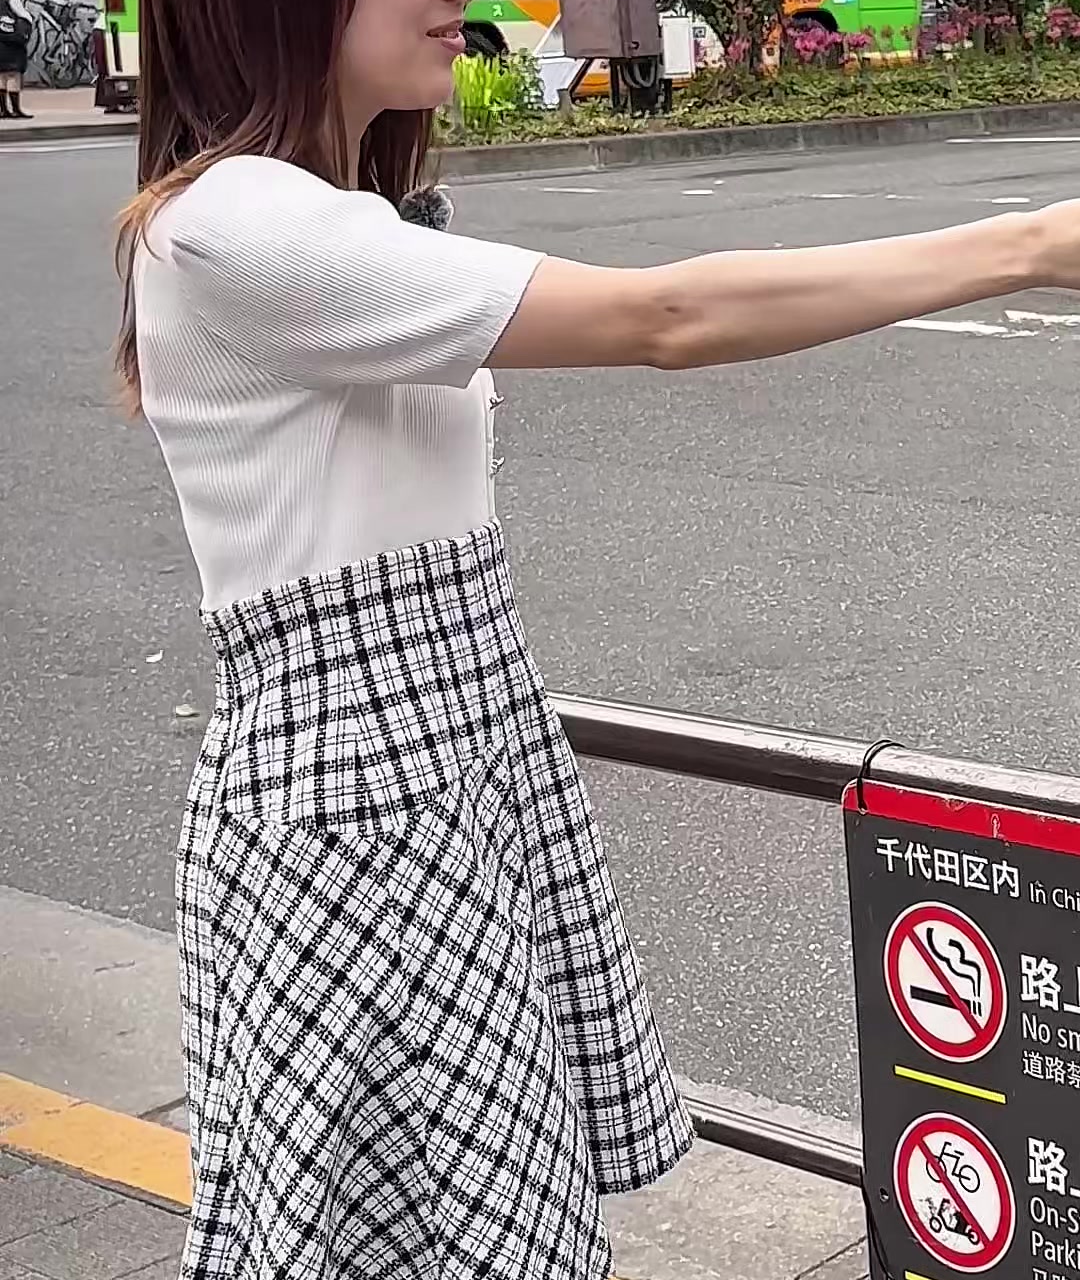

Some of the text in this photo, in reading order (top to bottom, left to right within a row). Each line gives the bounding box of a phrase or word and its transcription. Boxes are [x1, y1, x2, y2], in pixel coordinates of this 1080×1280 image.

[876, 837, 1020, 898] 千代田区内
[1030, 882, 1047, 905] In
[1022, 1013, 1051, 1044] No
